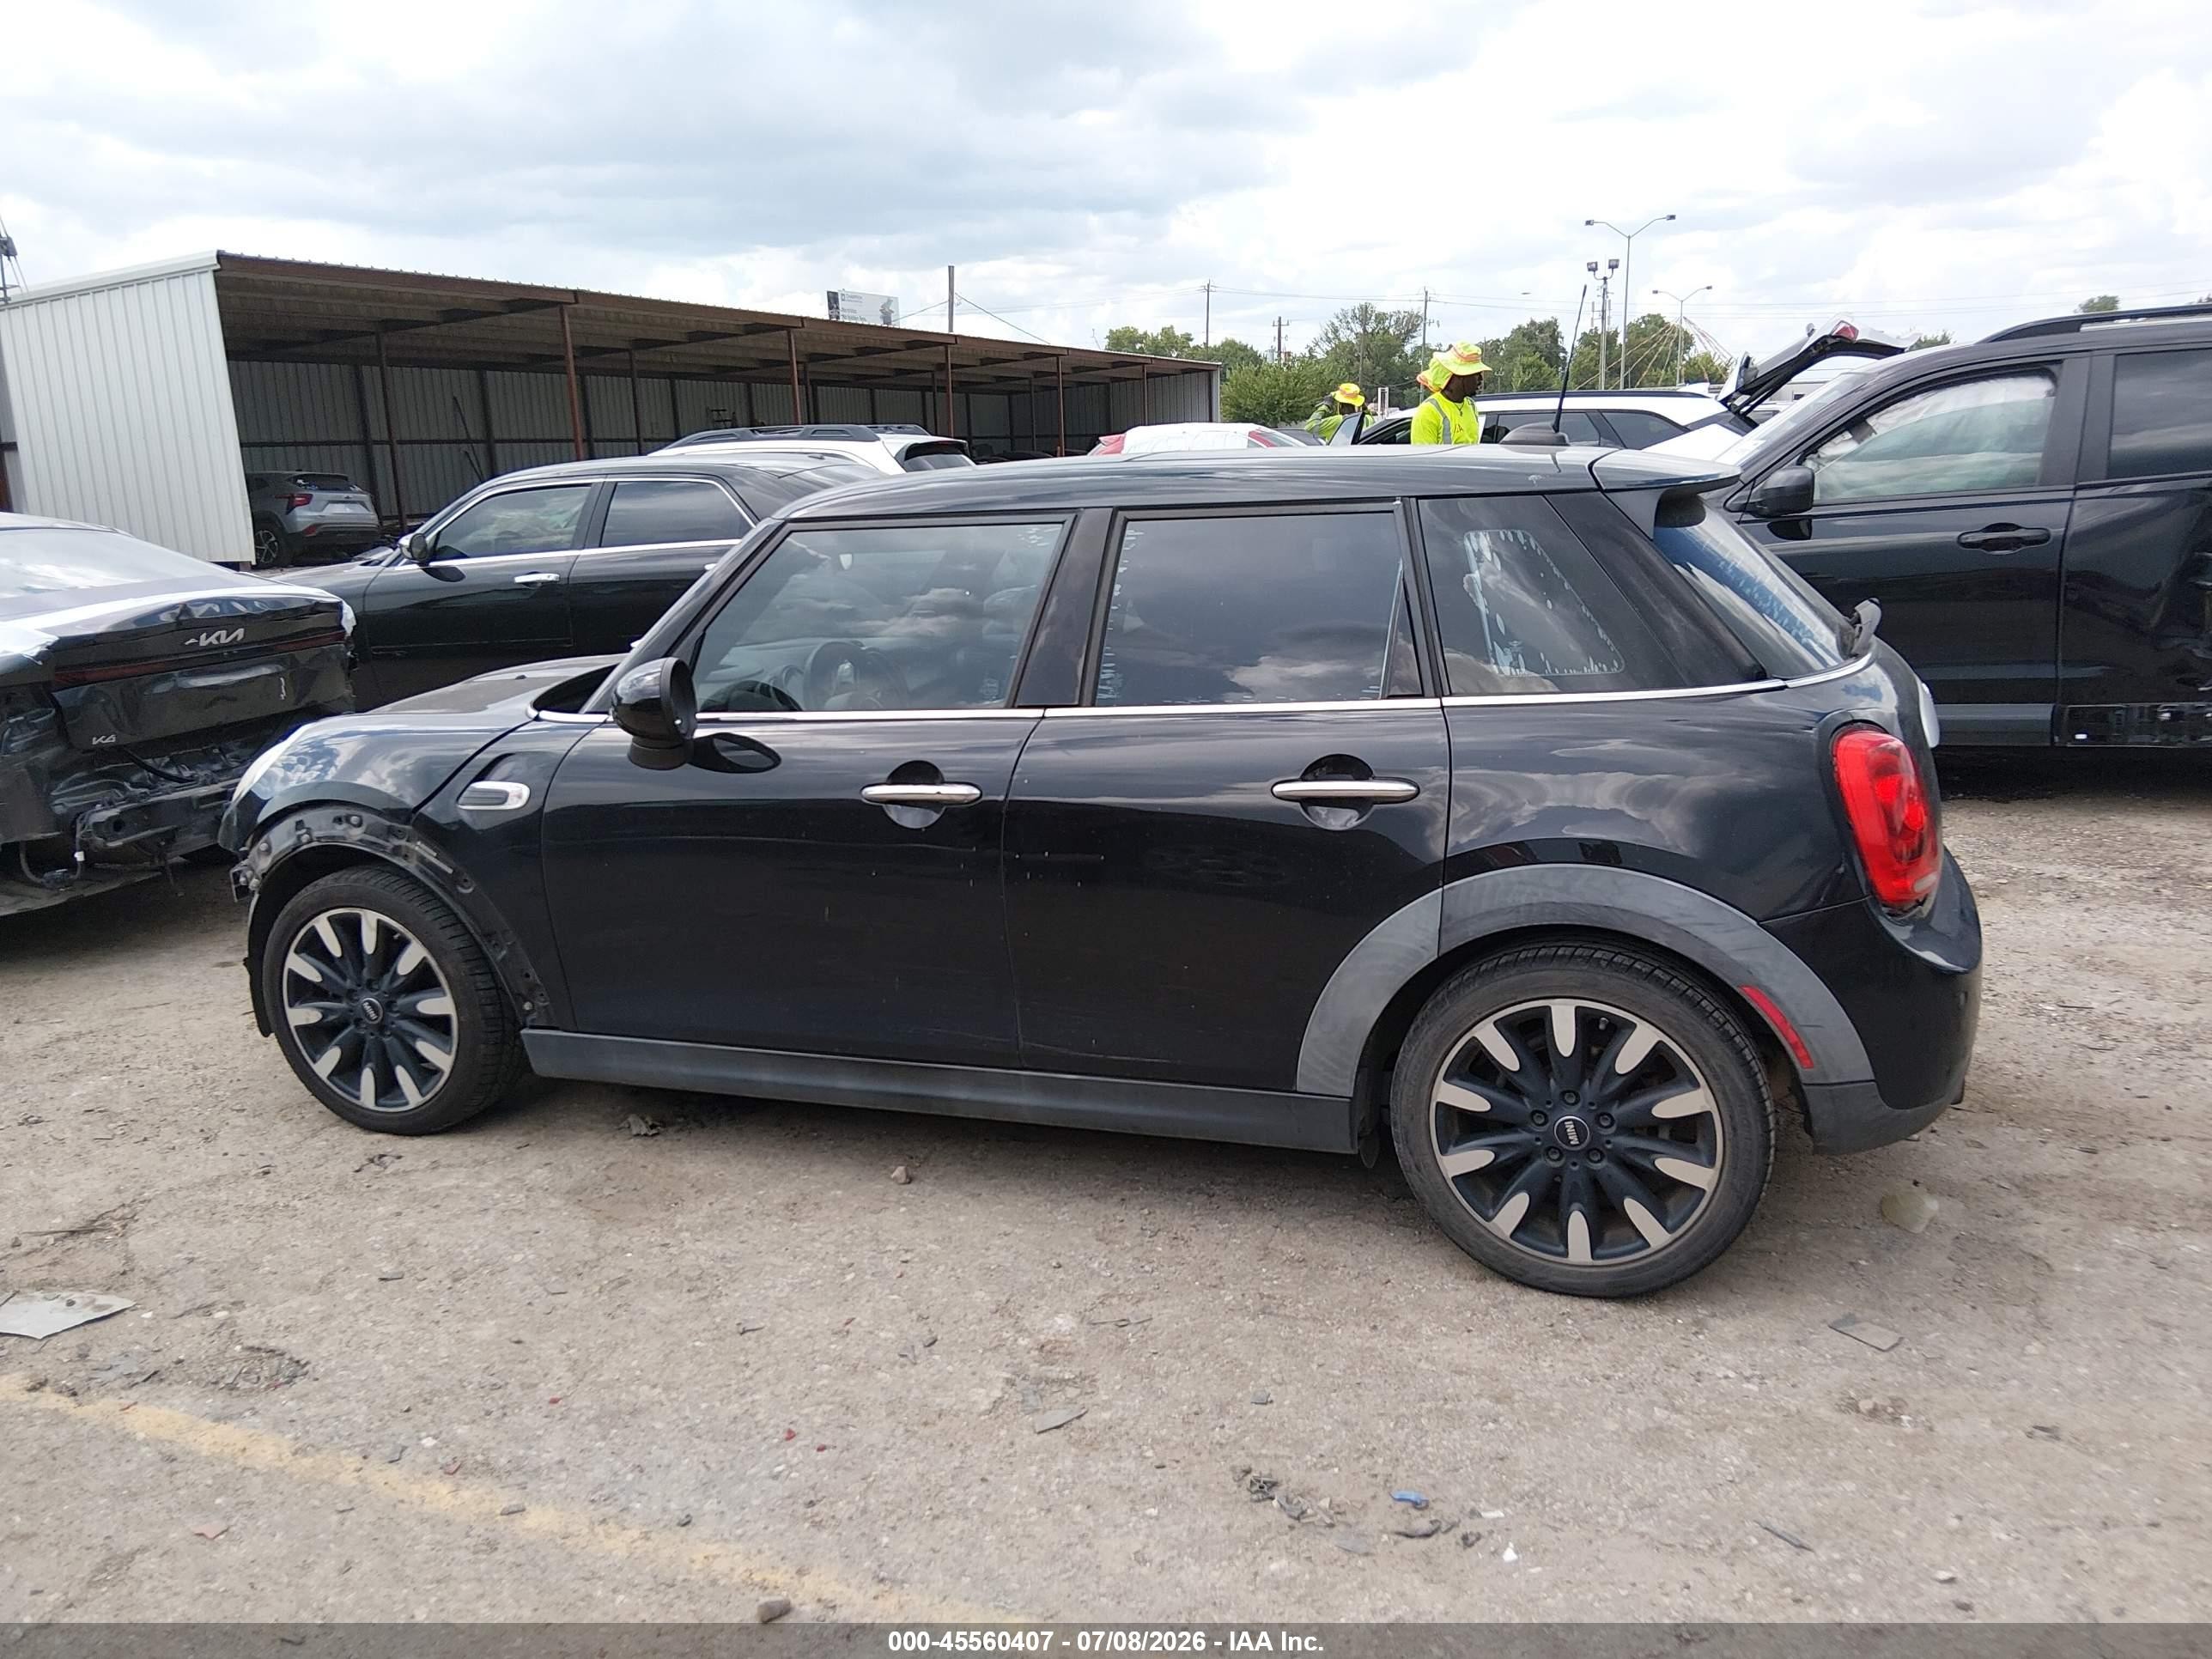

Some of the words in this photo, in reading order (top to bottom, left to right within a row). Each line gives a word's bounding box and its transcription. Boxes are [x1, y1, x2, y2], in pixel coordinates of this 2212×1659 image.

[199, 628, 245, 647] KIA
[92, 734, 116, 745] K4
[1564, 1121, 1580, 1145] MINI
